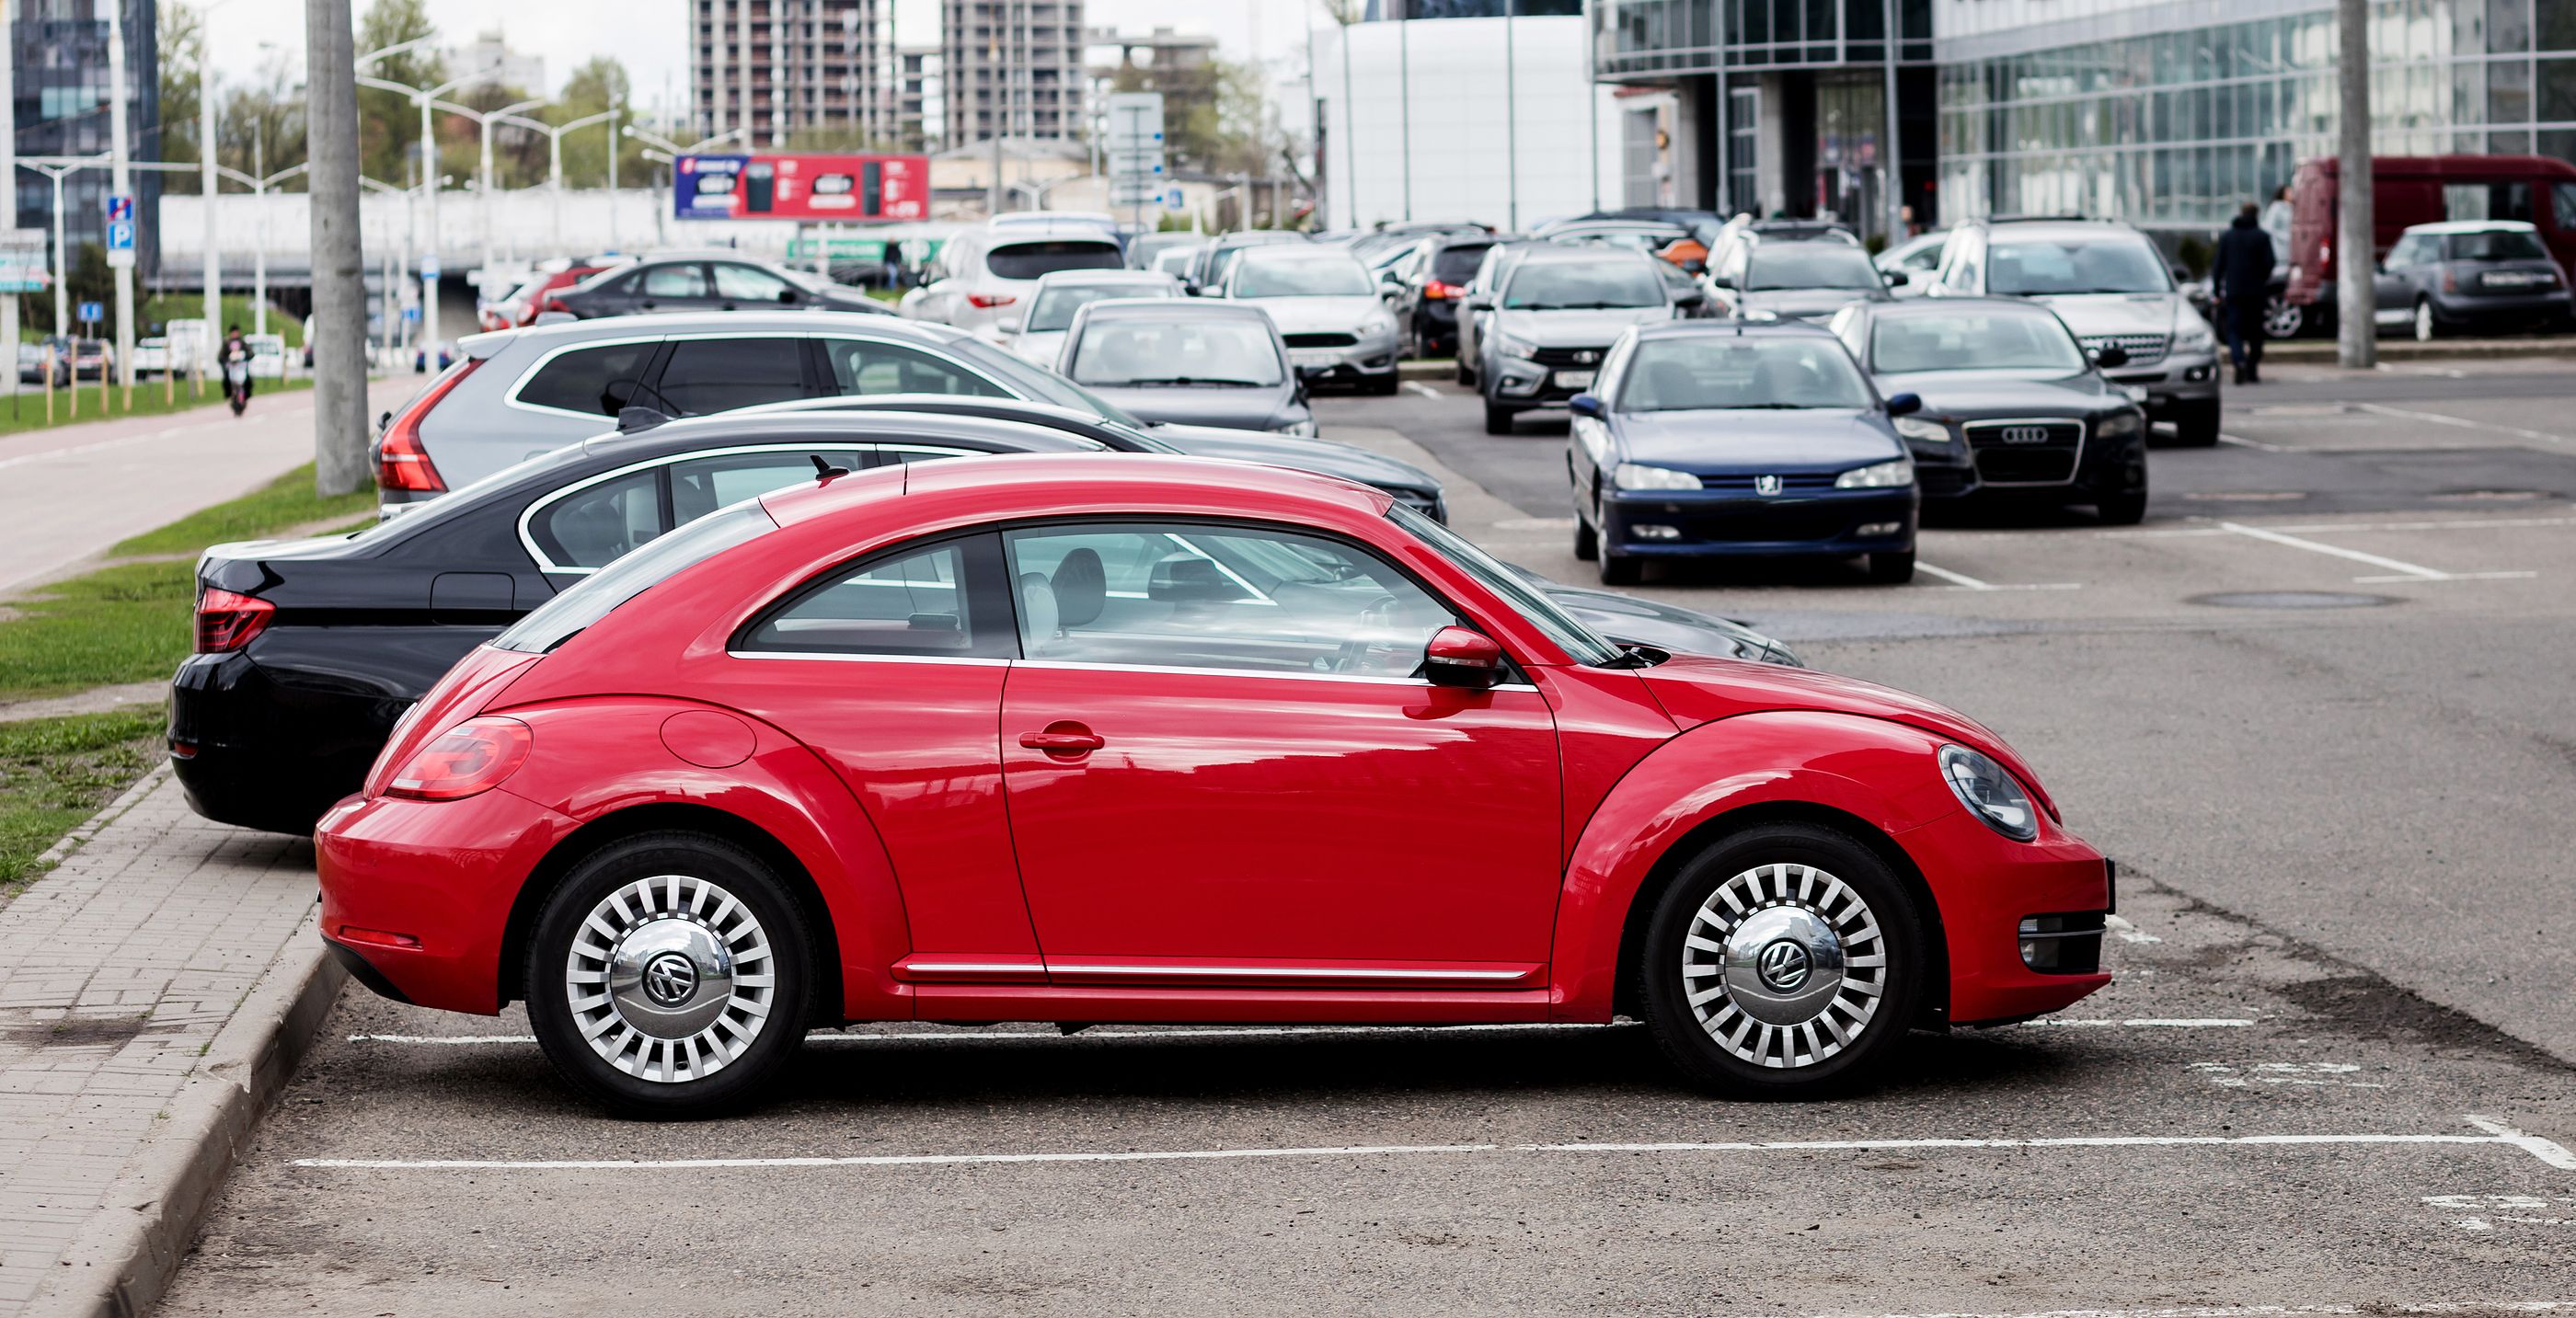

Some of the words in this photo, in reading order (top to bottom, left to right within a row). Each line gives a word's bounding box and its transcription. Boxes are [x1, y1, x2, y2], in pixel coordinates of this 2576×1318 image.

[114, 223, 131, 249] P
[646, 953, 696, 1003] VW
[1761, 940, 1809, 989] VW
